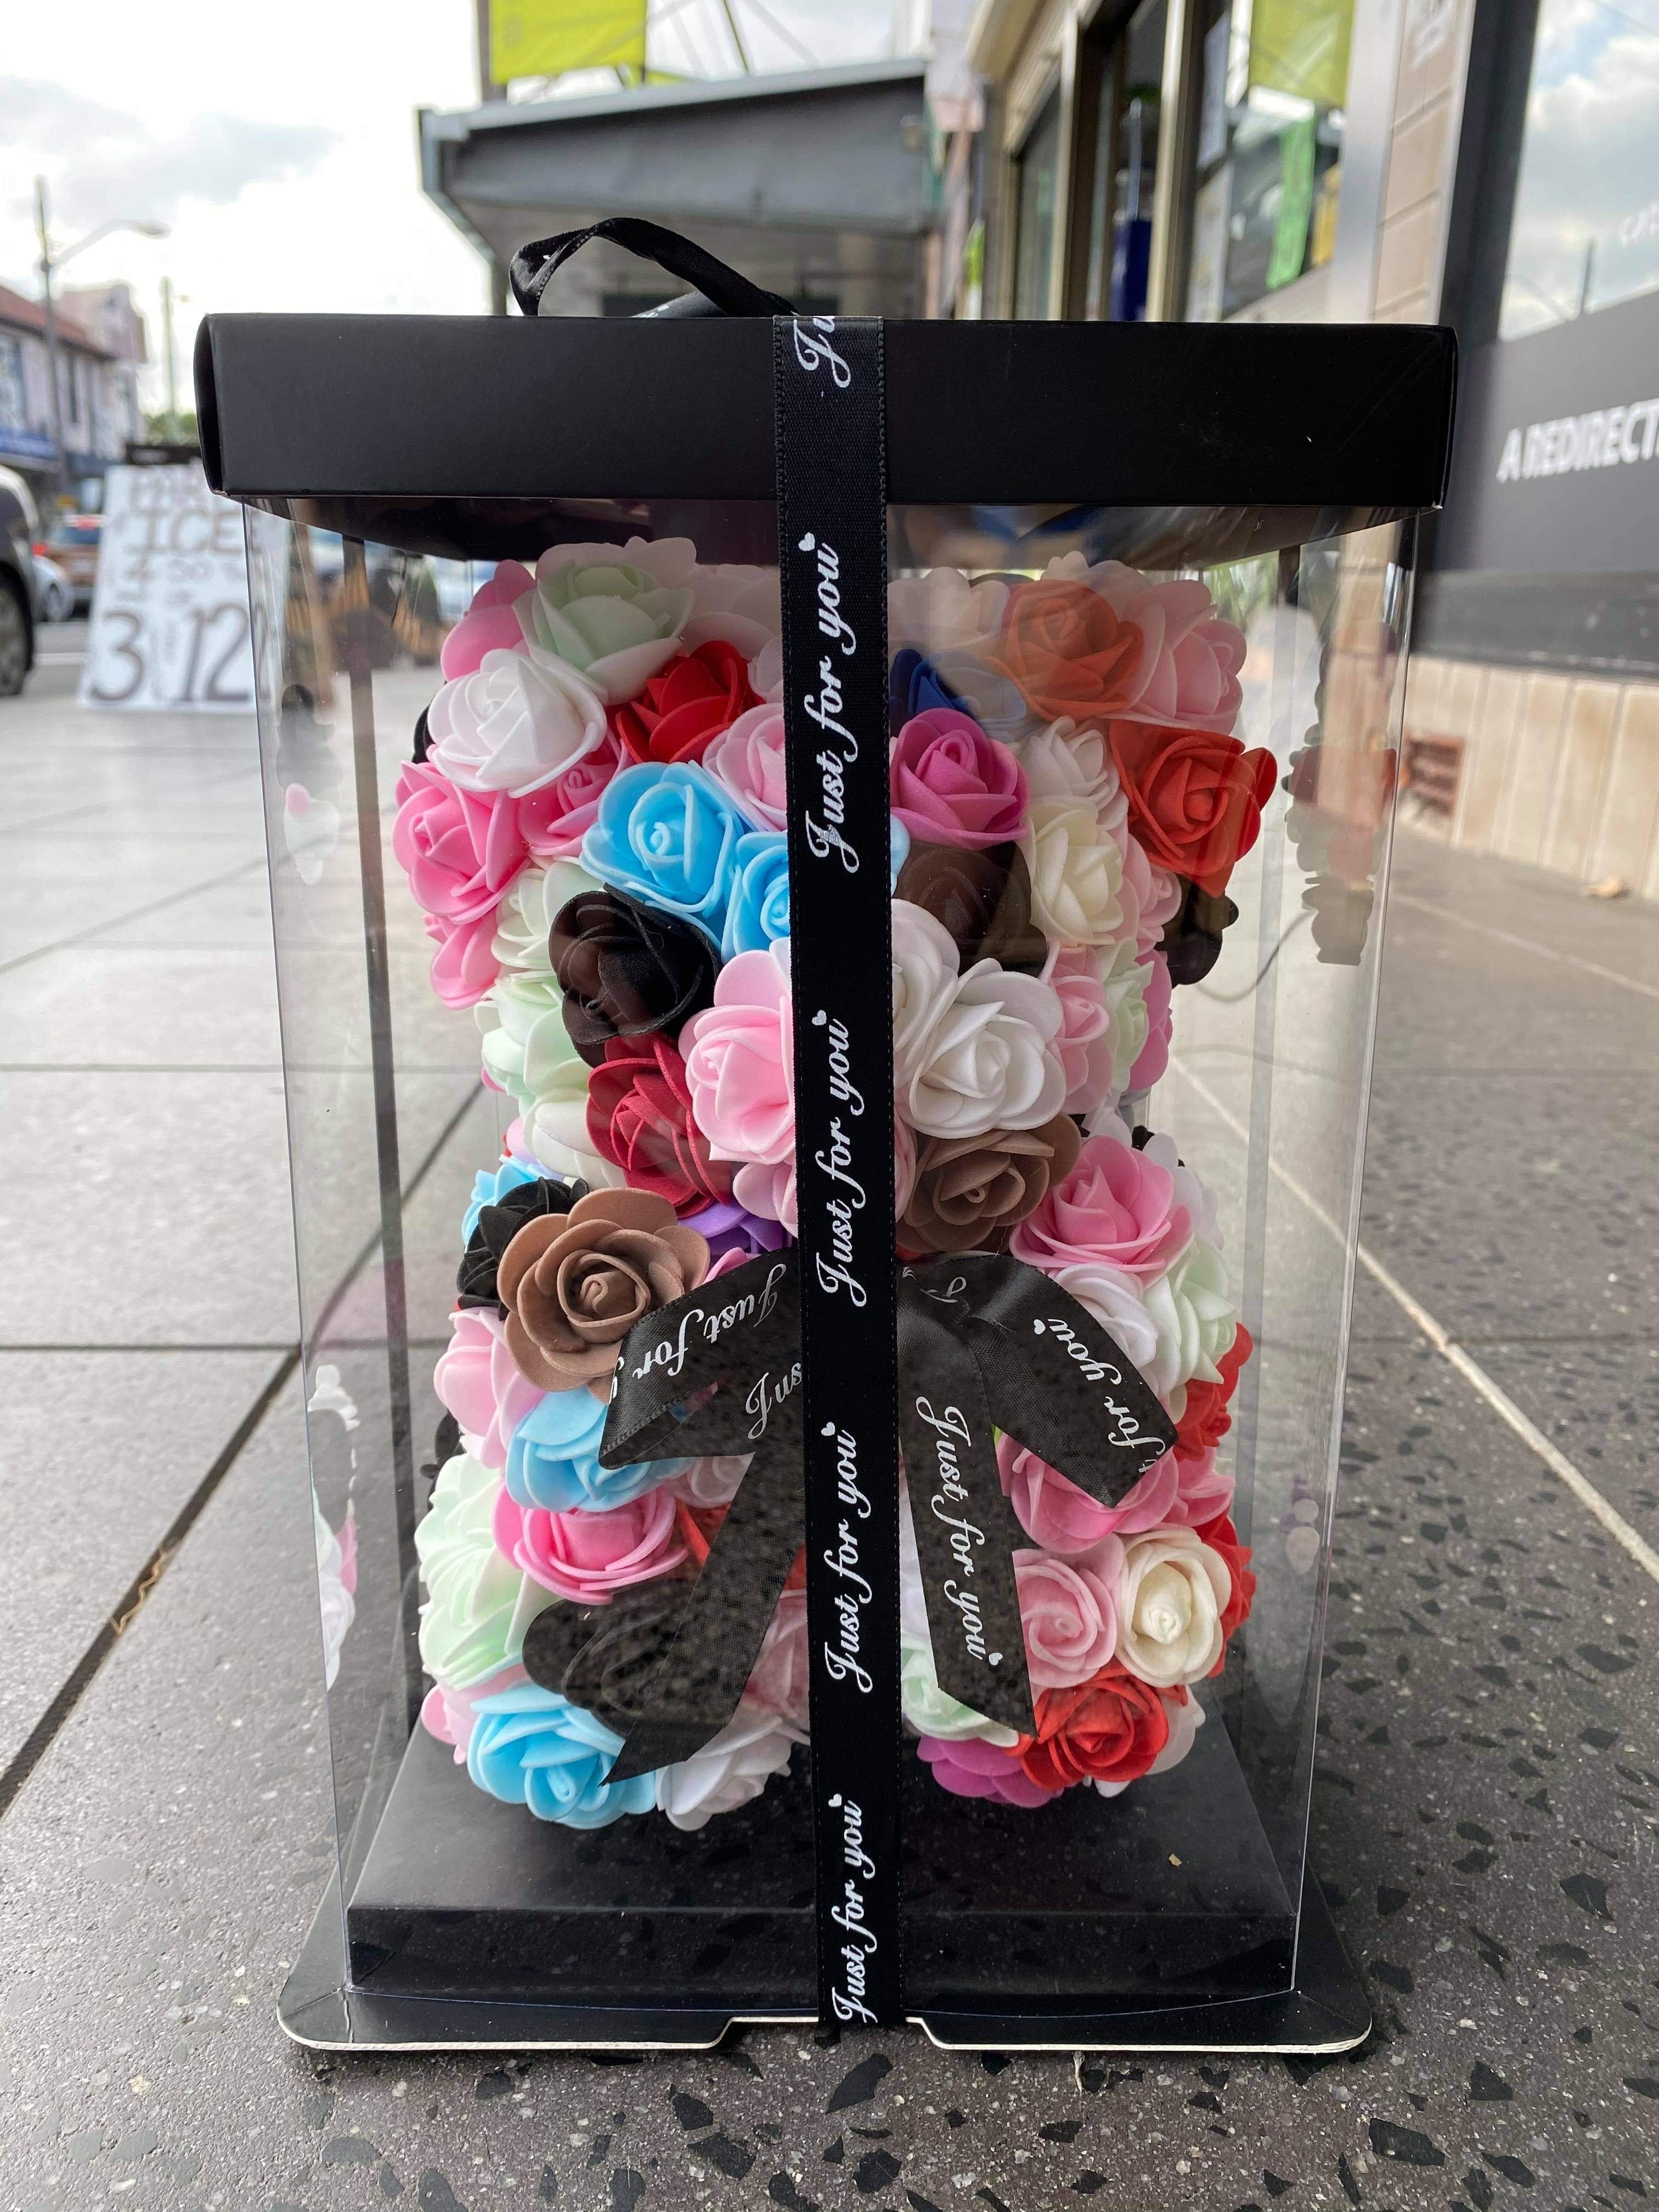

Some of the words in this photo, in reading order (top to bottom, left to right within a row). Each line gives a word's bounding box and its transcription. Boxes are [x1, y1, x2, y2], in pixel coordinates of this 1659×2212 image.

[1522, 398, 1659, 479] REDIRECT
[817, 543, 856, 656] you
[804, 656, 857, 762] for
[805, 749, 859, 873] Just
[829, 1018, 865, 1116] you
[815, 1116, 866, 1209] for
[816, 1199, 867, 1307] Just
[632, 1308, 705, 1379] for
[1048, 1318, 1122, 1385] you
[745, 1363, 802, 1440] Jus
[1103, 1396, 1165, 1455] for
[837, 1429, 871, 1519] you
[916, 1396, 972, 1502] Just
[823, 1518, 872, 1604] for
[932, 1494, 985, 1577] for
[825, 1593, 873, 1692] Just
[944, 1579, 990, 1660] you
[843, 1800, 876, 1880] you
[832, 1879, 877, 1953] for
[832, 1944, 878, 2023] Just
